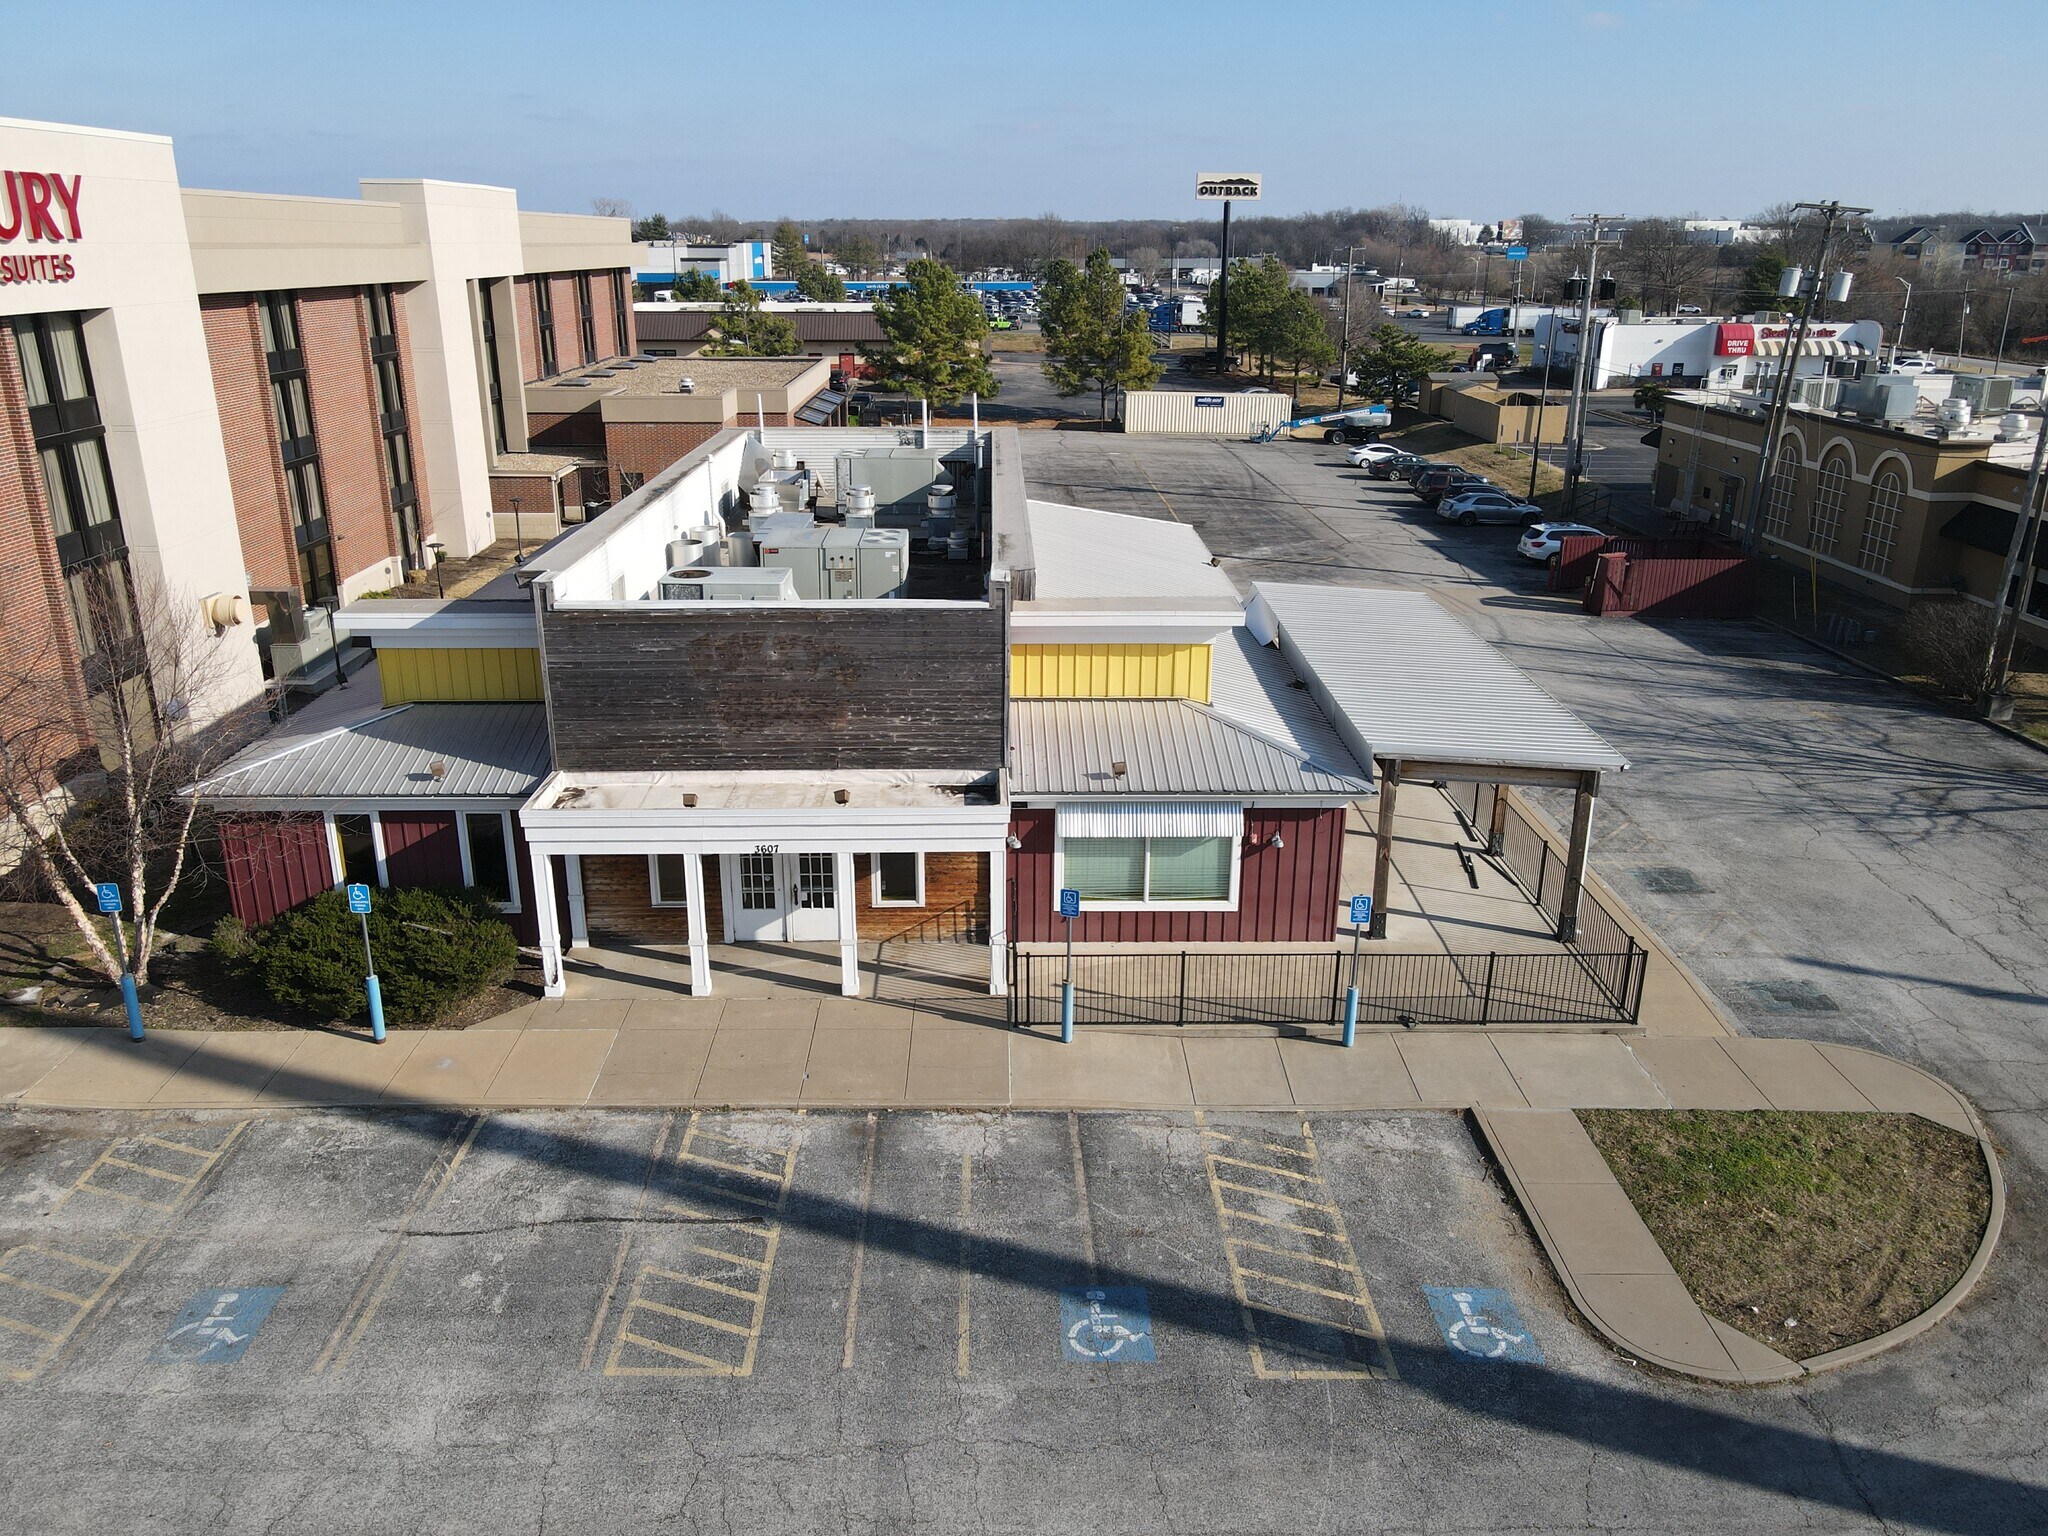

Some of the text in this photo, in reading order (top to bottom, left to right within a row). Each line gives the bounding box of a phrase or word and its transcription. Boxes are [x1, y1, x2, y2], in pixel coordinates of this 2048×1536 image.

[1198, 186, 1258, 196] OUTBACK
[0, 253, 75, 282] SUITES
[754, 844, 779, 854] 3607
